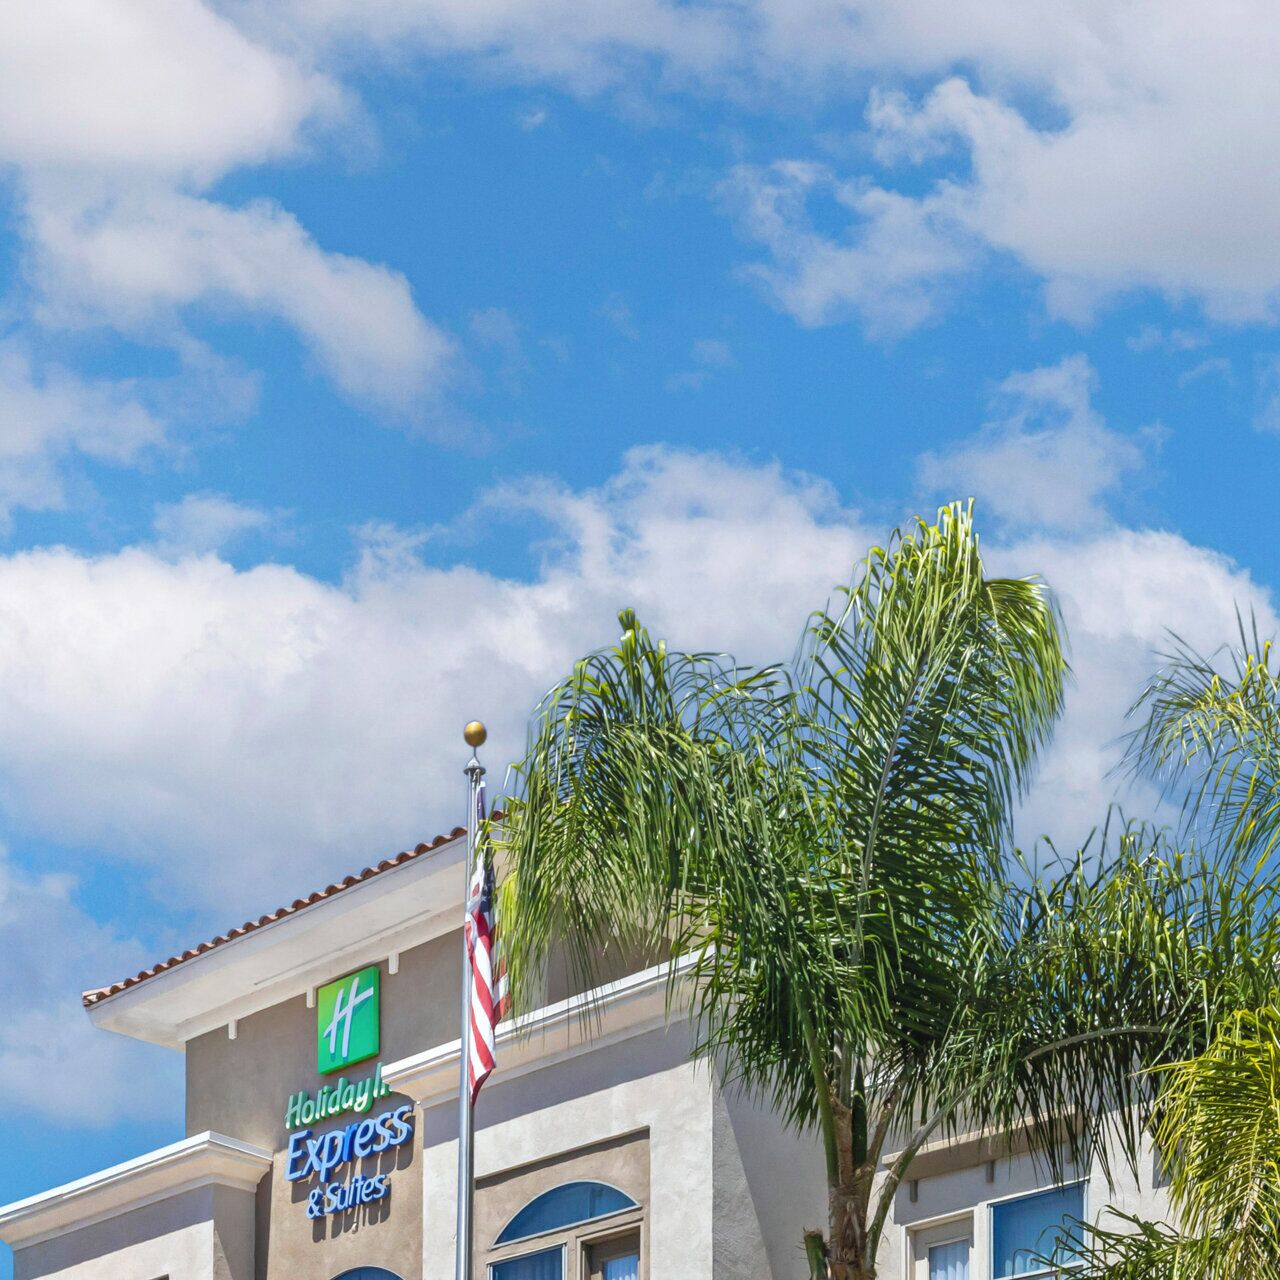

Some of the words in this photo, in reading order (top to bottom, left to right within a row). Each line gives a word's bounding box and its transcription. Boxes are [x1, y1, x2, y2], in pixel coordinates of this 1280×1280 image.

[285, 1077, 374, 1131] Holiday
[285, 1104, 413, 1184] Express
[305, 1186, 325, 1220] &
[323, 1174, 389, 1214] Suites
